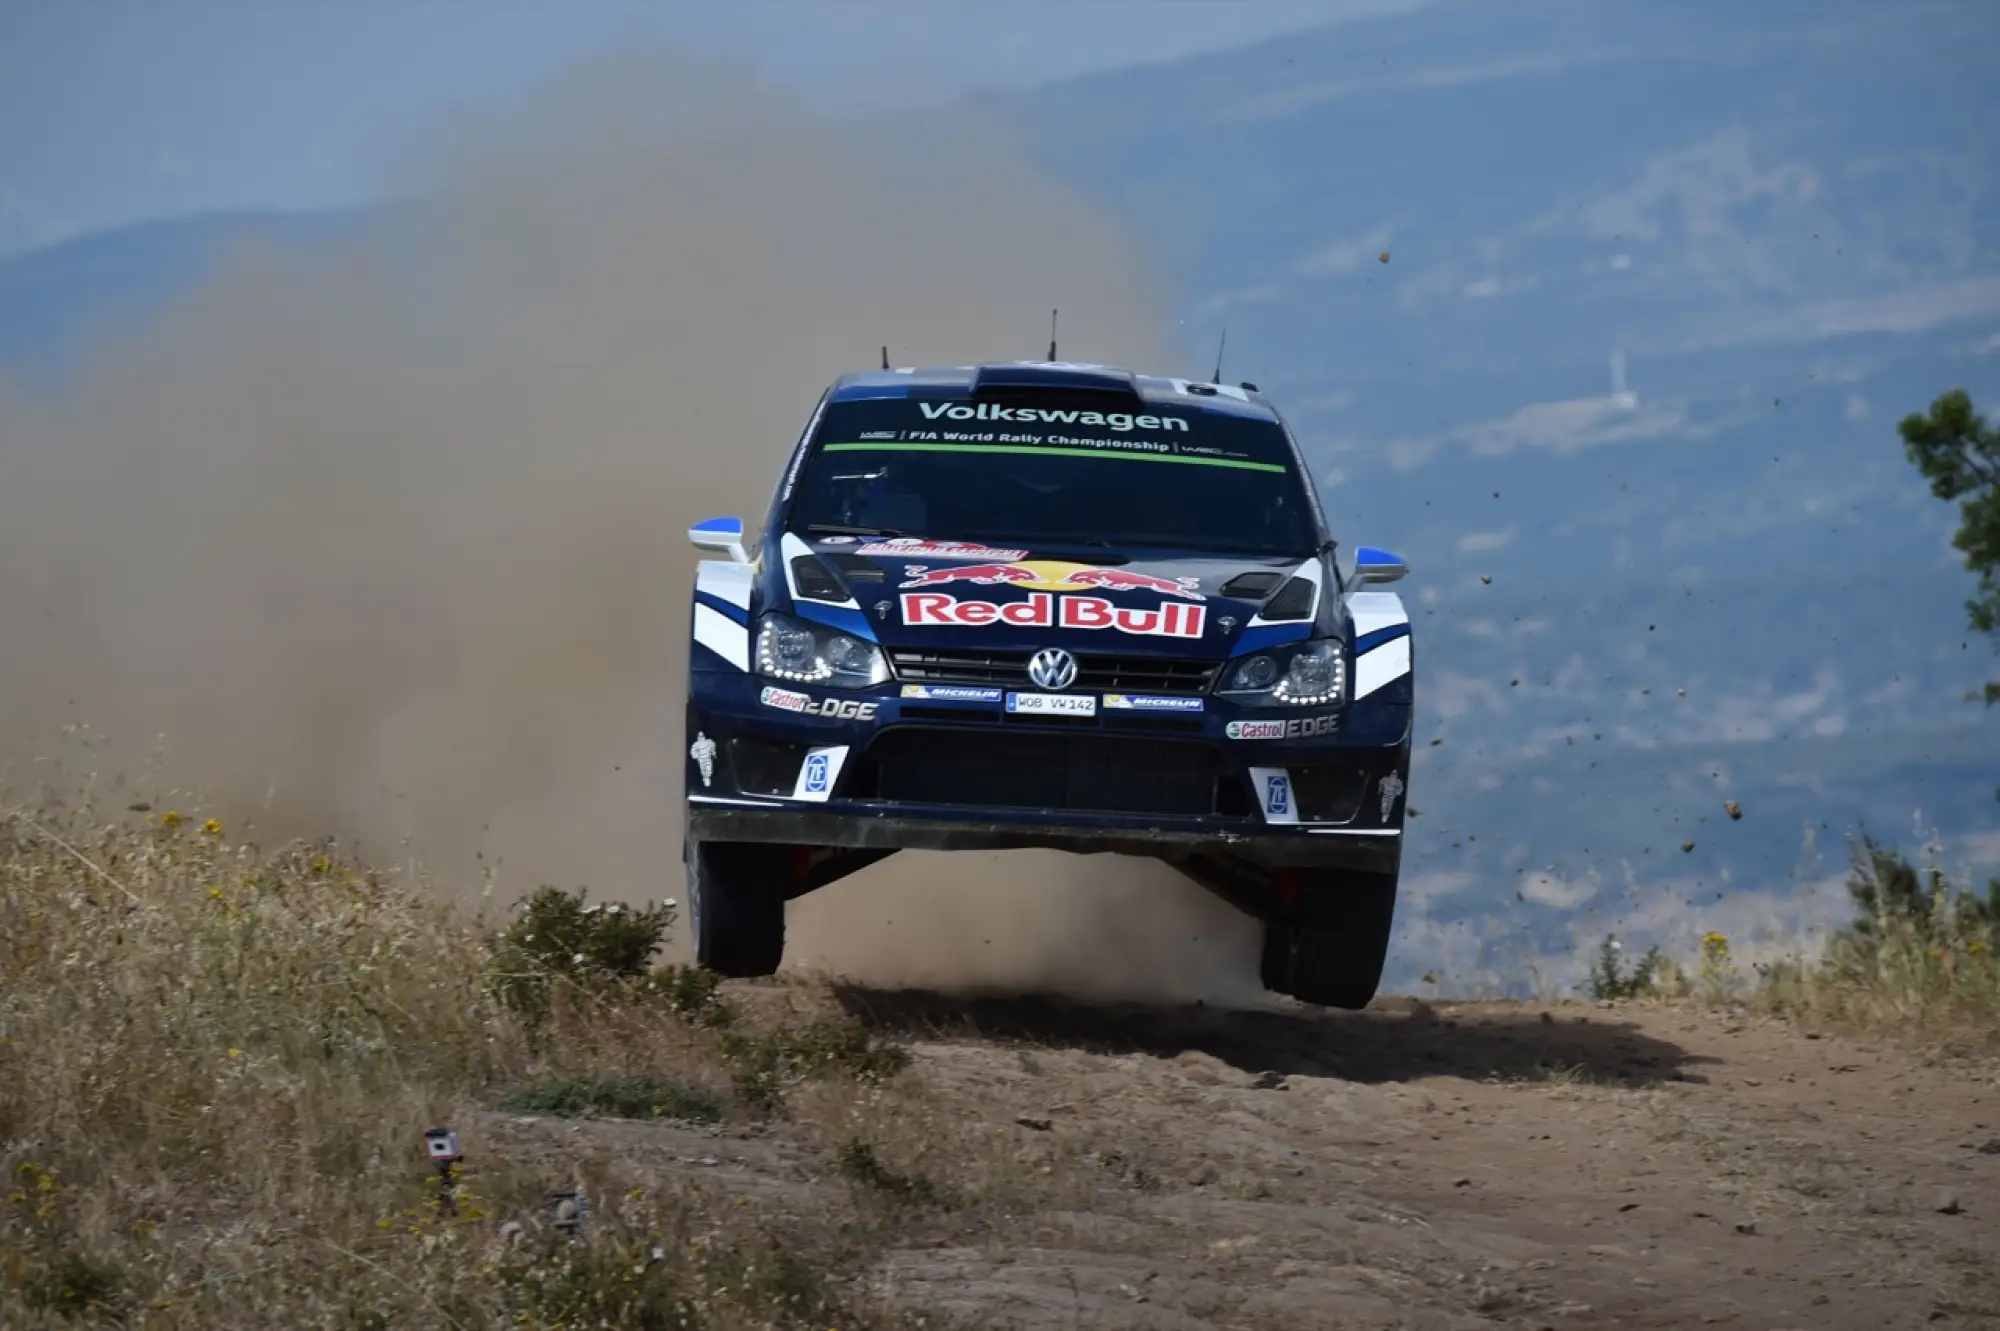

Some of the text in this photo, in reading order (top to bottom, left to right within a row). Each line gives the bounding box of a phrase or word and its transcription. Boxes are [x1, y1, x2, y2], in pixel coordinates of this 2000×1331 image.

[919, 403, 1189, 431] Volkswagen
[909, 431, 937, 440] FIA
[943, 432, 994, 441] World
[999, 434, 1042, 444] Rally
[1047, 435, 1169, 452] Championship
[904, 593, 1202, 635] Red Bull
[1028, 648, 1078, 689] VW
[931, 689, 998, 698] MICHELIN
[1018, 697, 1043, 709] WOB
[1133, 698, 1200, 707] MICHELIN
[1241, 714, 1339, 738] Castrol EDGE
